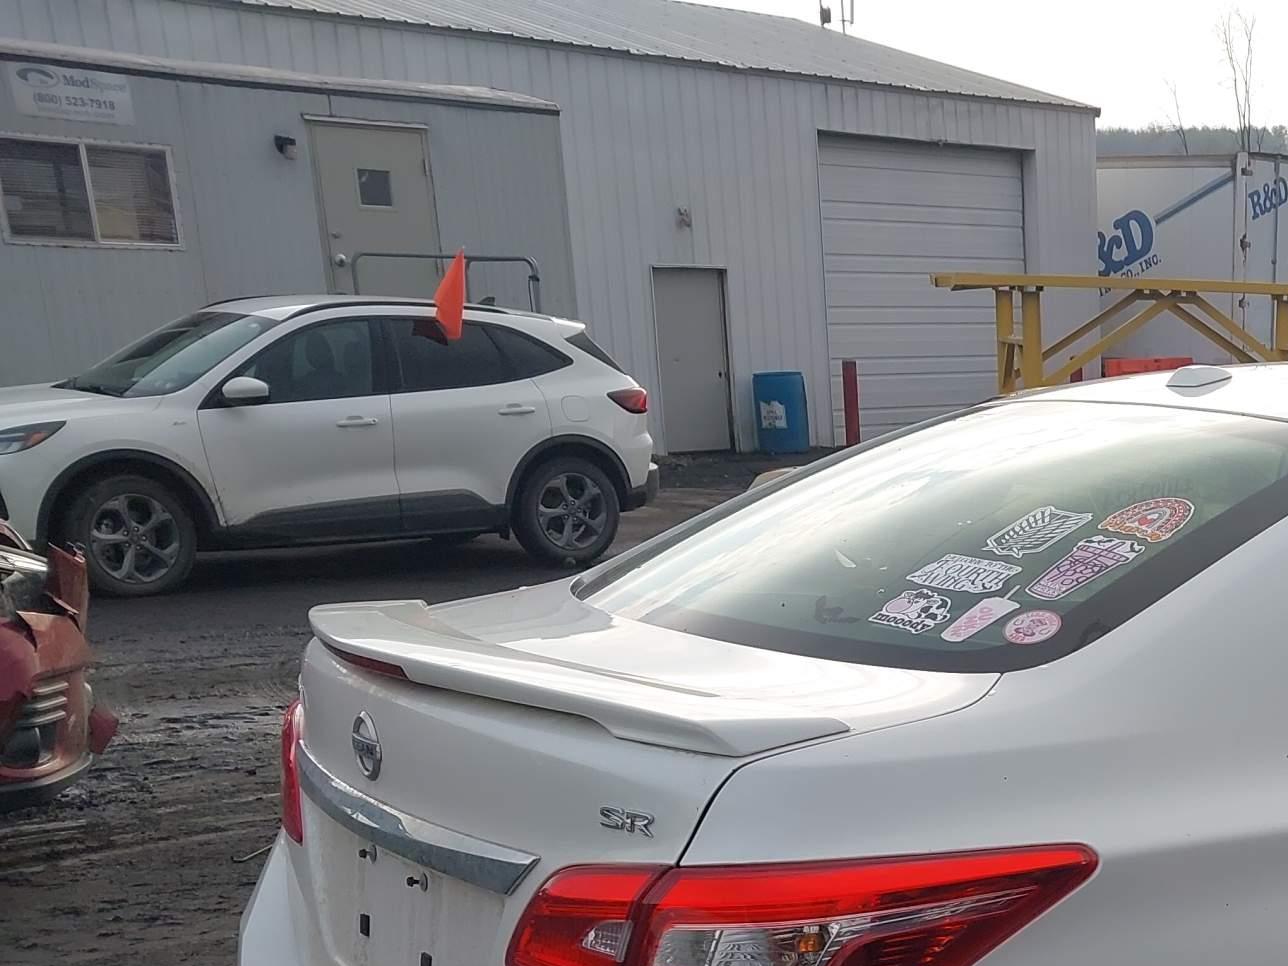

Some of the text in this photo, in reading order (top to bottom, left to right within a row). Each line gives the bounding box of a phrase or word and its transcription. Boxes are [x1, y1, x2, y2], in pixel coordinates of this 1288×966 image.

[33, 91, 116, 111] (800) 523-7918
[1248, 177, 1288, 220] R&D
[600, 806, 655, 839] SR
